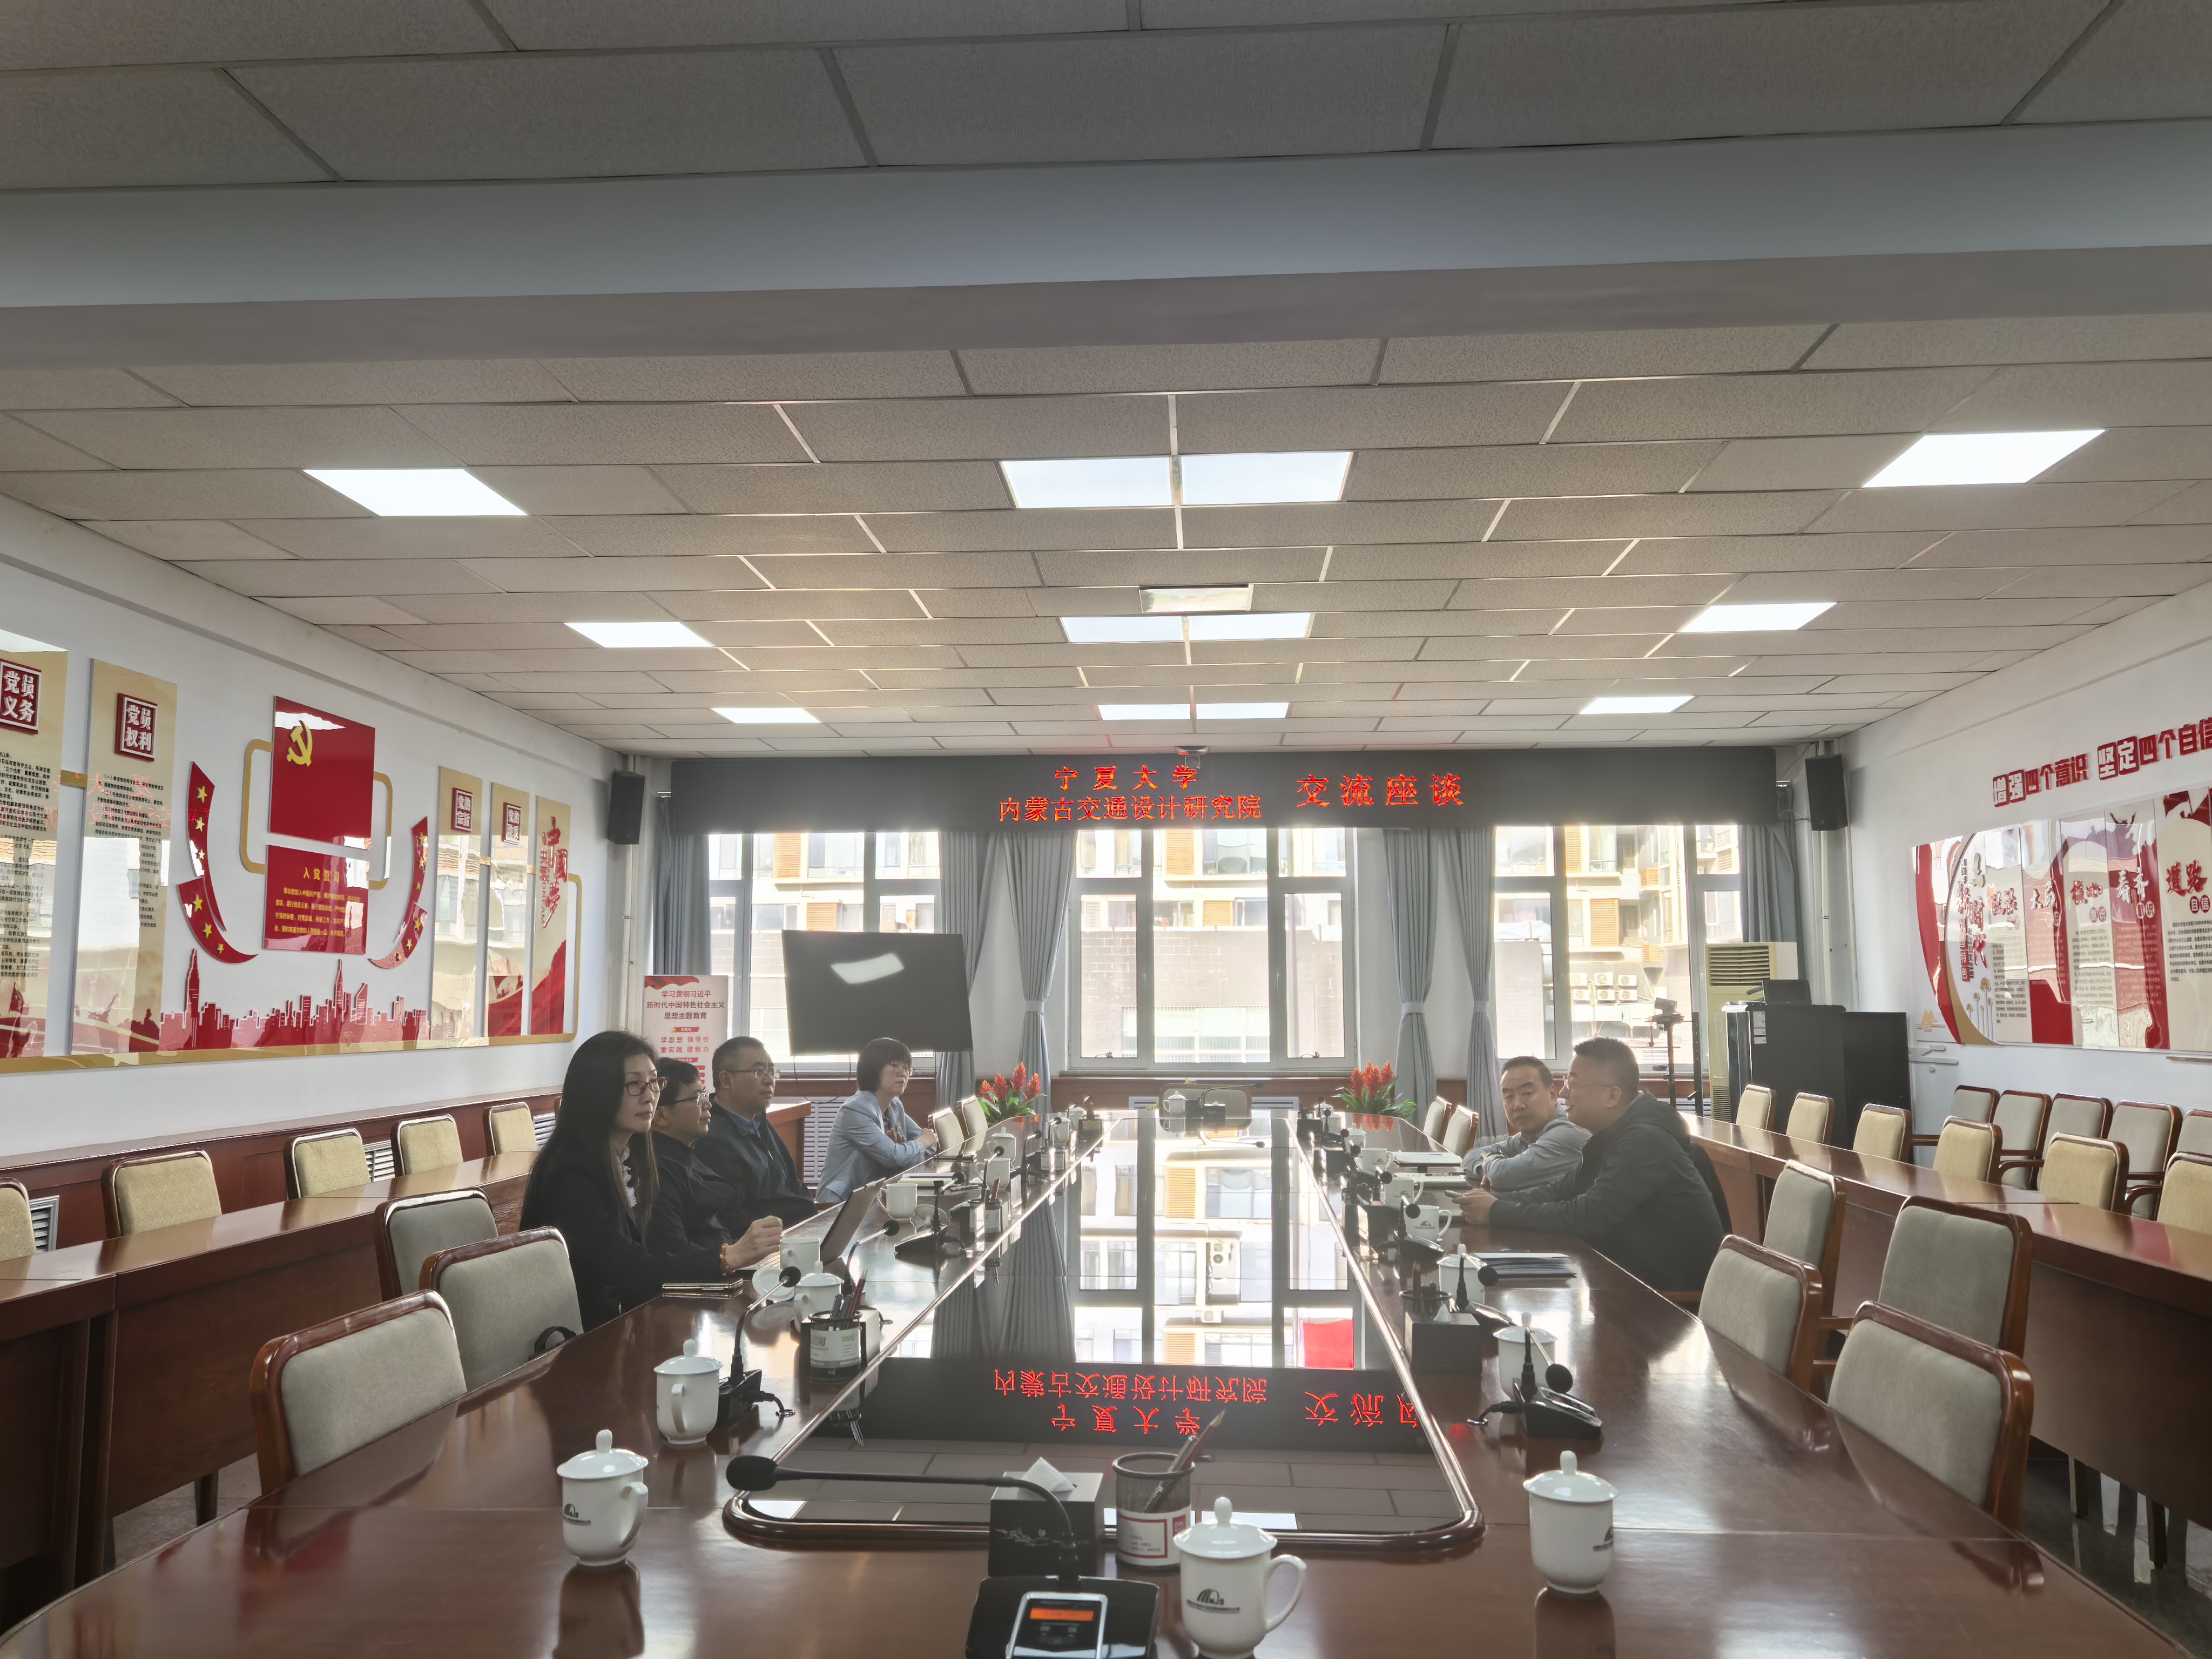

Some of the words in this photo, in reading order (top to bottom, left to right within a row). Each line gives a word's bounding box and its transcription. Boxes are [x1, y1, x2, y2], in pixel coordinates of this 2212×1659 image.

[3, 671, 34, 699] 党员
[2, 696, 35, 722] 义务
[126, 705, 151, 730] 党员
[125, 727, 152, 751] 权利
[1055, 765, 1197, 791] 宁夏大学
[1297, 773, 1464, 807] 交流座谈
[1993, 753, 2090, 805] 增强四个意识
[1000, 794, 1262, 822] 内蒙古交通设计研究院
